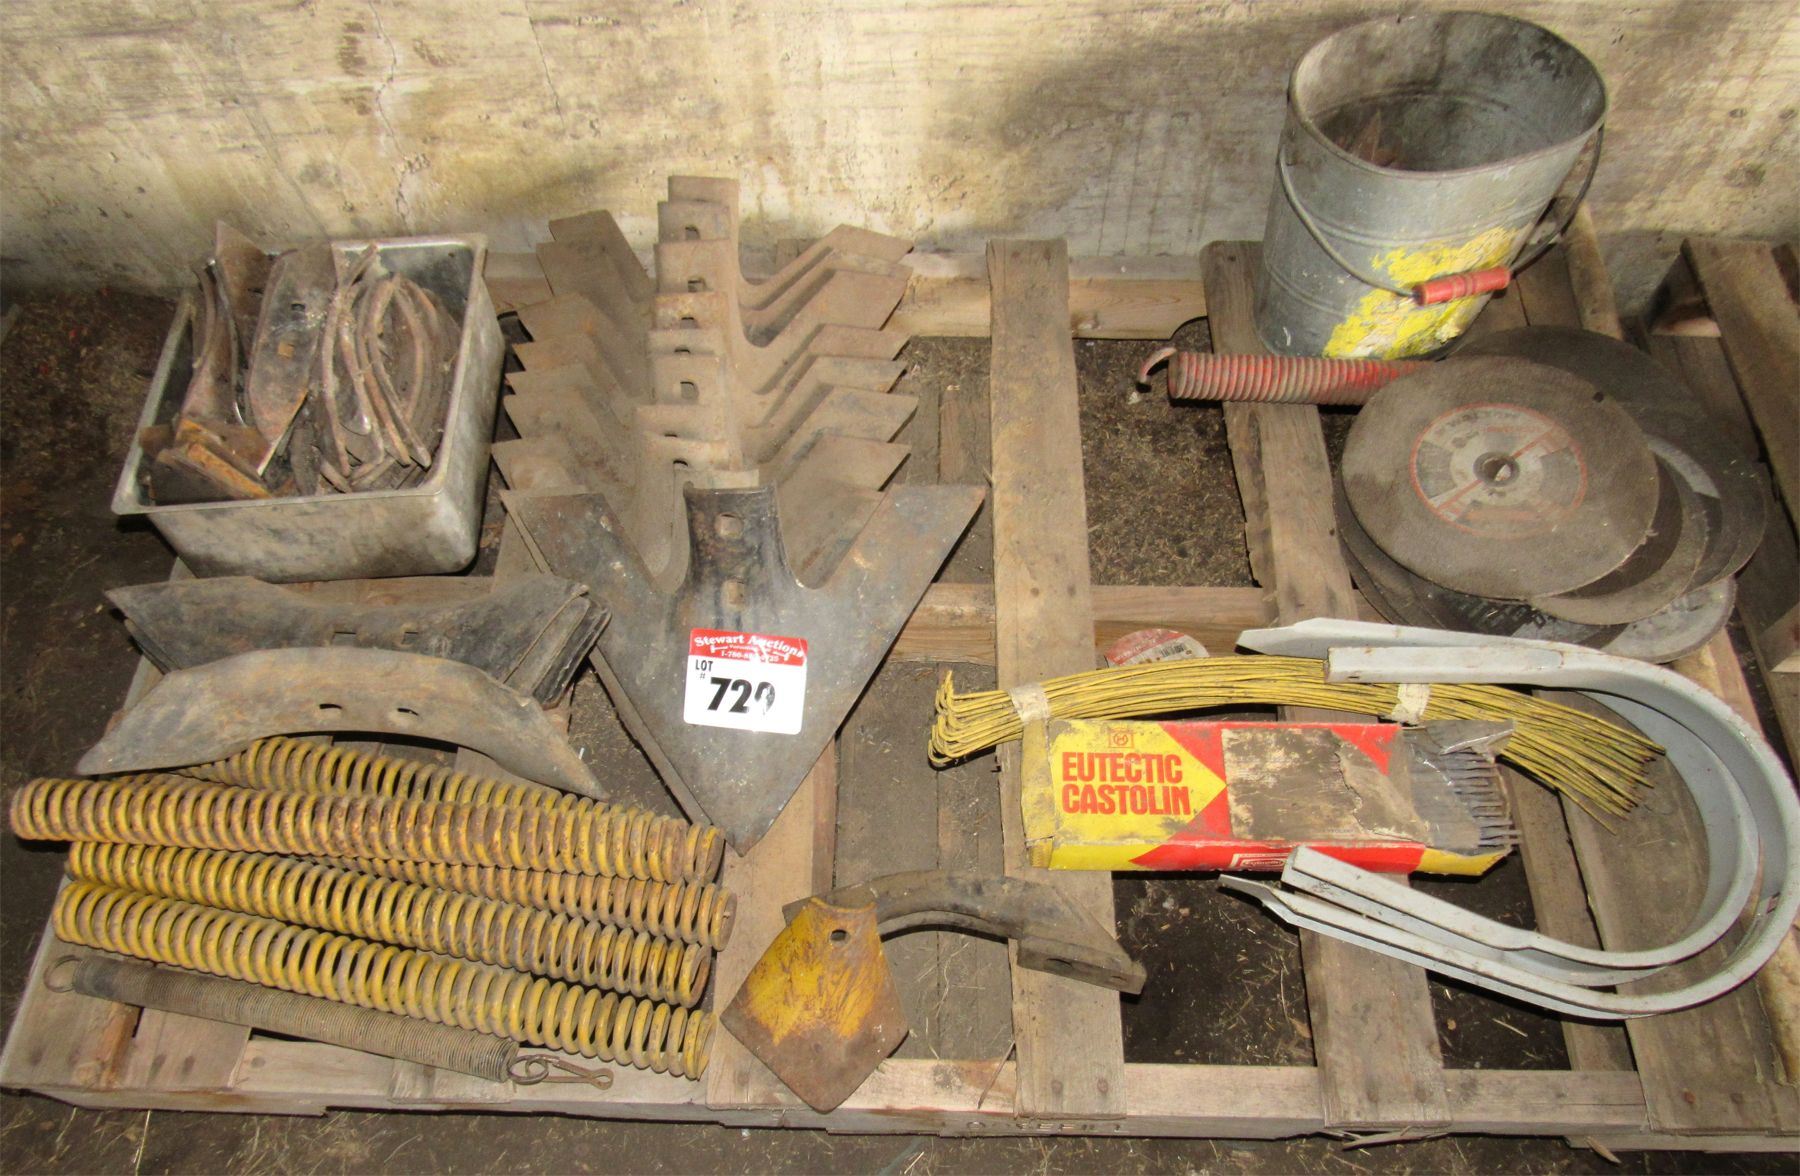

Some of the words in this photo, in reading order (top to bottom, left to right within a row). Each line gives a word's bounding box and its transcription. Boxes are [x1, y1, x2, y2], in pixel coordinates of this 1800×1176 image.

[694, 635, 745, 647] Stewart
[695, 659, 713, 672] LOT
[1062, 751, 1183, 784] EUTECTIC
[1062, 783, 1191, 816] CASTOLIN
